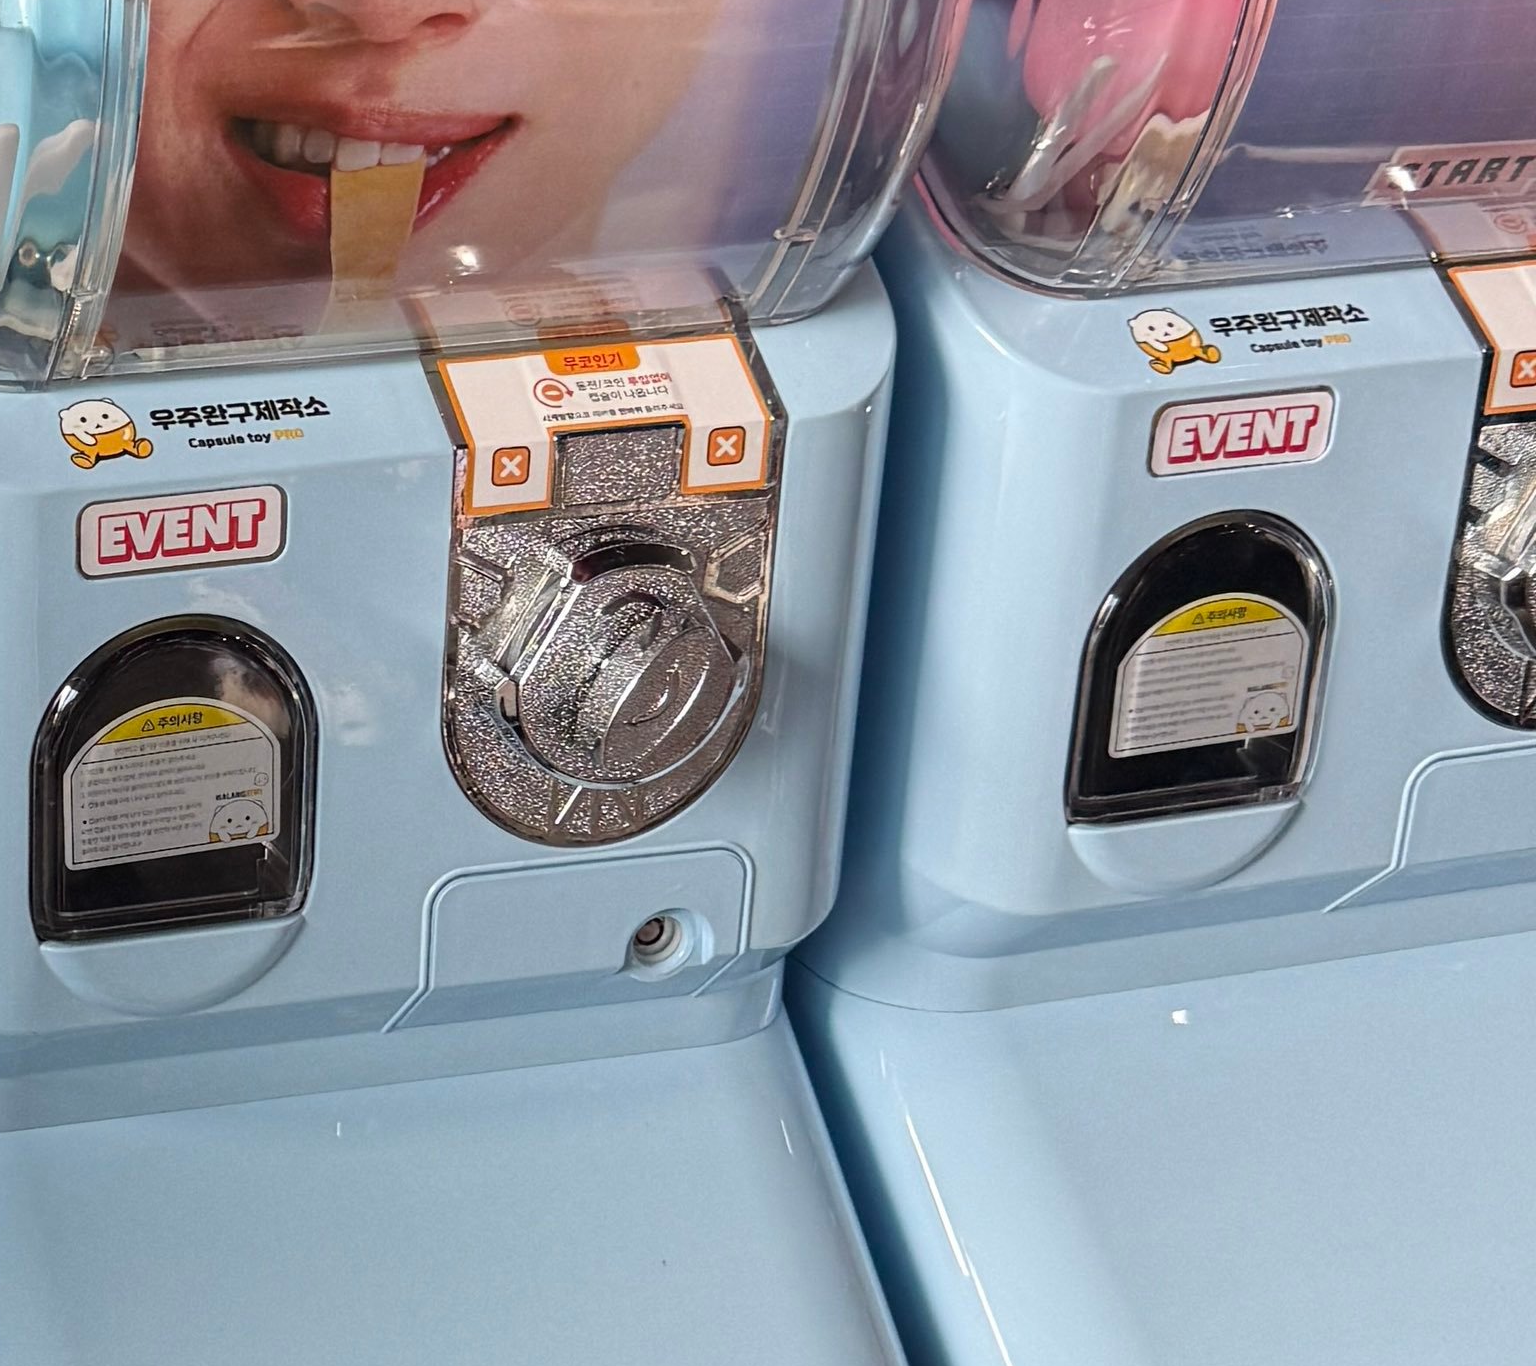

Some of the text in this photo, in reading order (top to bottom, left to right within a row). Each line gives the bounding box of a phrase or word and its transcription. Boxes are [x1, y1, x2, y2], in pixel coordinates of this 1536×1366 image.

[1210, 304, 1369, 336] 우주완구제작소
[1250, 338, 1300, 354] Capsule
[564, 352, 624, 370] 무코인기
[149, 396, 330, 430] 우주완구제작소
[188, 428, 305, 449] Capsule toy PRO
[1168, 405, 1319, 464] EVENT
[98, 498, 266, 565] EVENT
[157, 712, 204, 730] 주의사항
